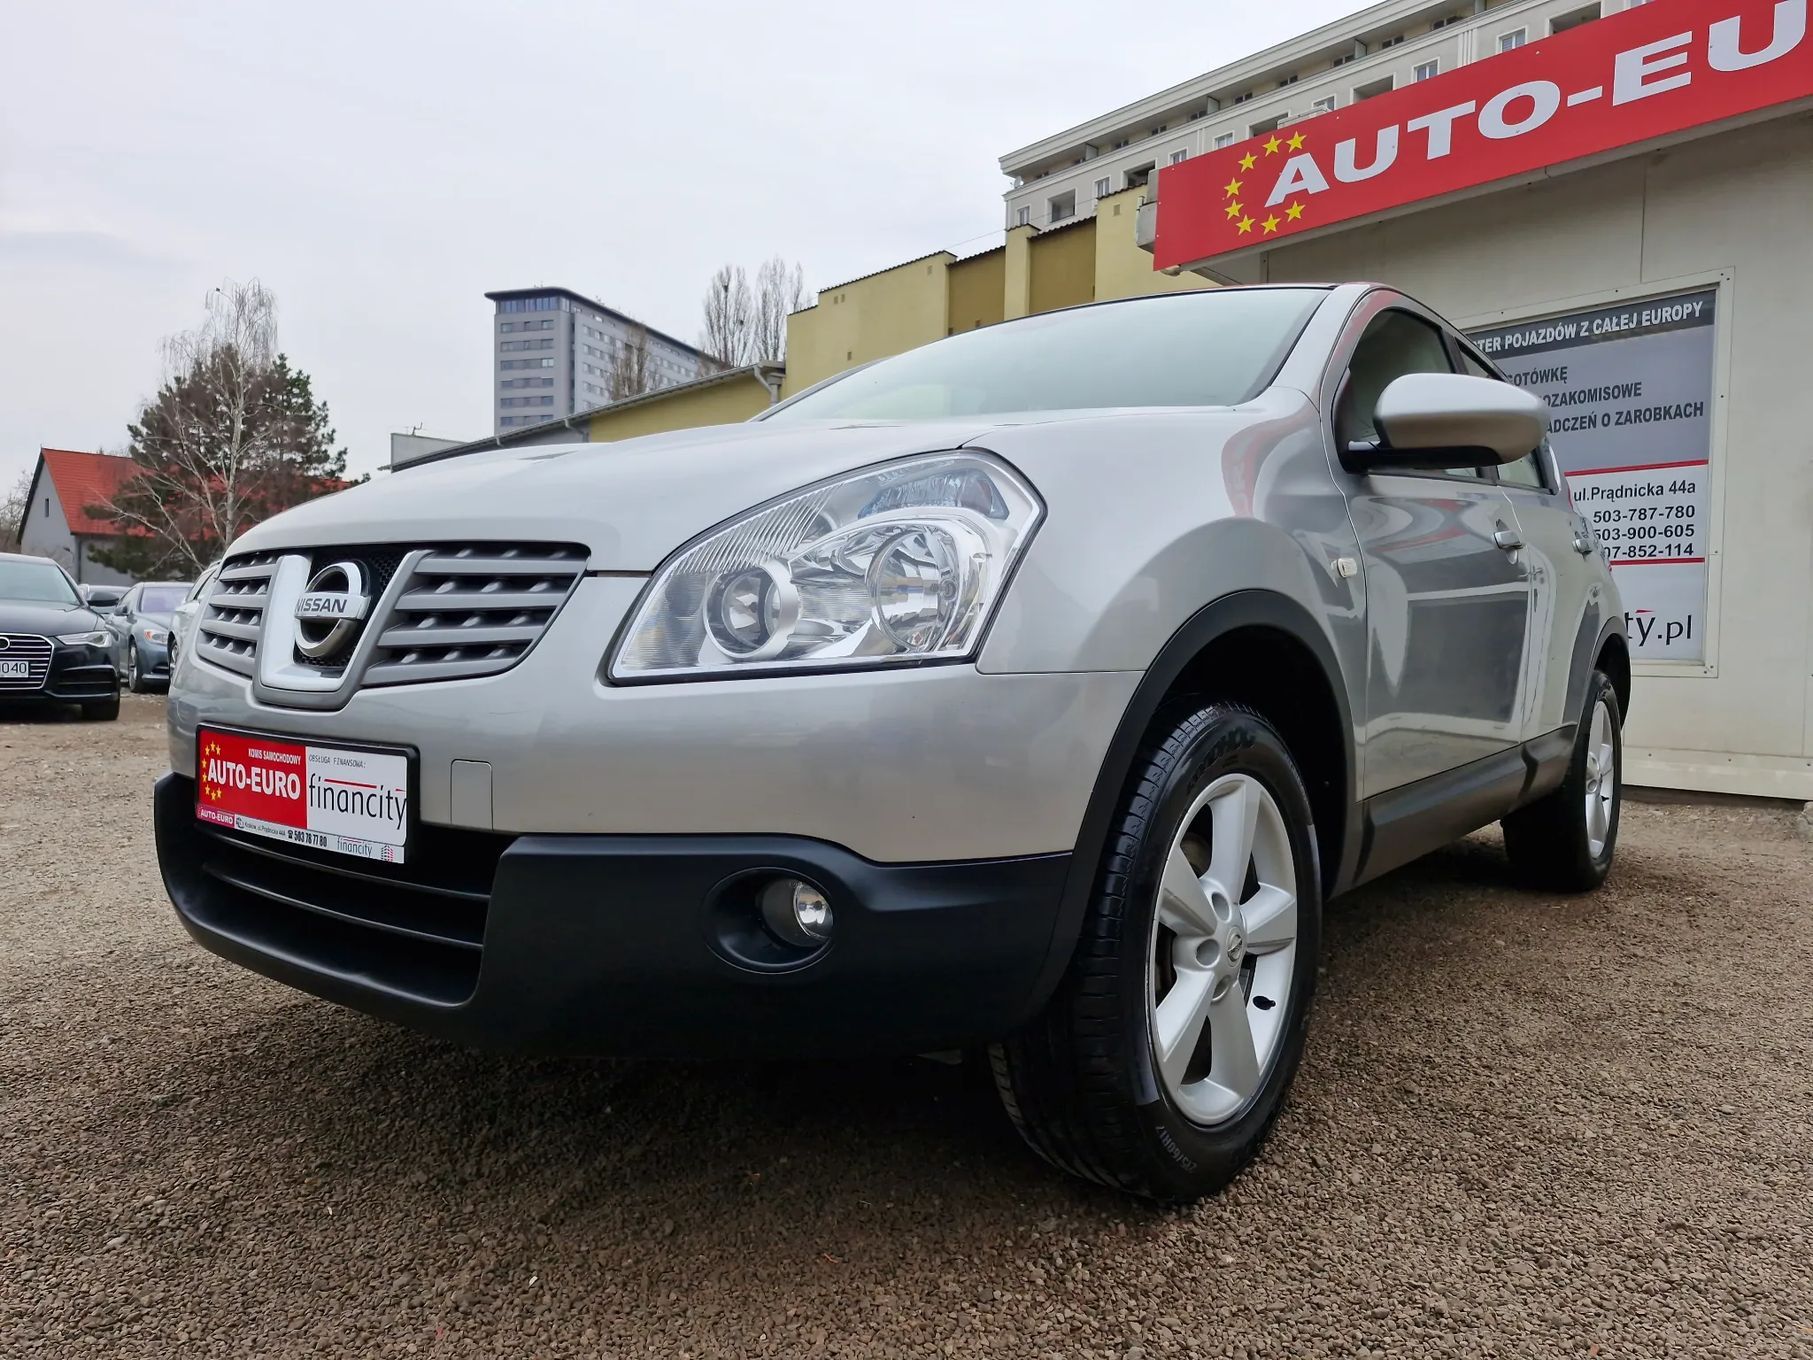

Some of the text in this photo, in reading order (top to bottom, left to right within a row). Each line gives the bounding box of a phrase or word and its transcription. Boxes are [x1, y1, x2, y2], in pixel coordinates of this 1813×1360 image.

[1264, 0, 1807, 208] AUTO-EU
[1474, 301, 1703, 353] TER POJAZDÓW Z CAŁEJ EUROPY
[1540, 381, 1642, 408] OZAKOMISOWE
[1546, 401, 1704, 434] ADCZEŃ O ZAROBKACH
[1573, 480, 1696, 502] ul.Prądnicka 44a
[1593, 505, 1695, 523] 503-787-780
[1595, 524, 1695, 541] 503-900-605
[1604, 543, 1694, 559] 07-852-114
[296, 598, 348, 613] NISSAN
[0, 662, 28, 674] 040
[207, 758, 301, 800] AUTO-EURO
[309, 773, 407, 830] financity
[200, 809, 234, 825] AUTO-EURO
[337, 835, 373, 858] financity
